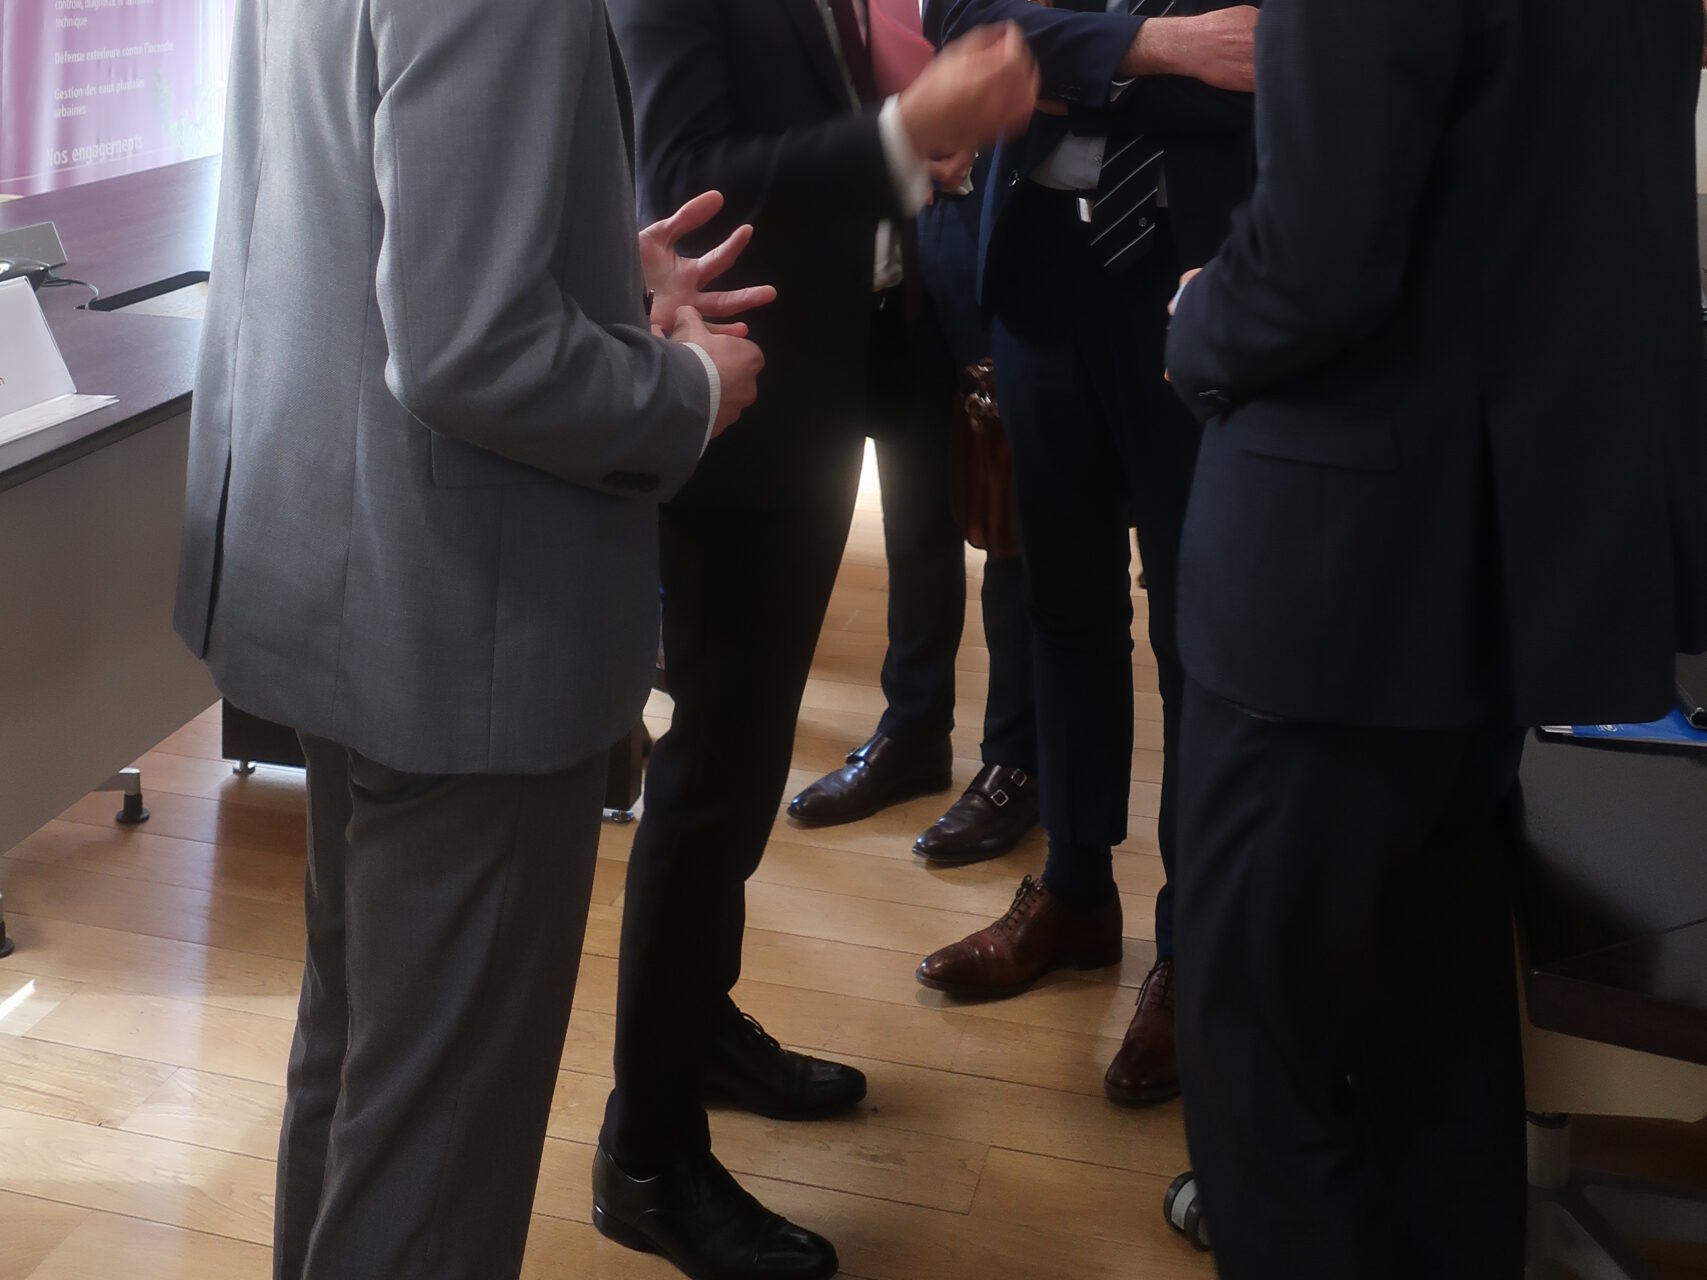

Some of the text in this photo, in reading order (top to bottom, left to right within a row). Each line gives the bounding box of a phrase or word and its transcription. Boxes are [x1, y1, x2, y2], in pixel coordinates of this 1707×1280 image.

[54, 86, 83, 100] Gestion
[85, 83, 97, 96] des
[72, 135, 144, 164] engagements
